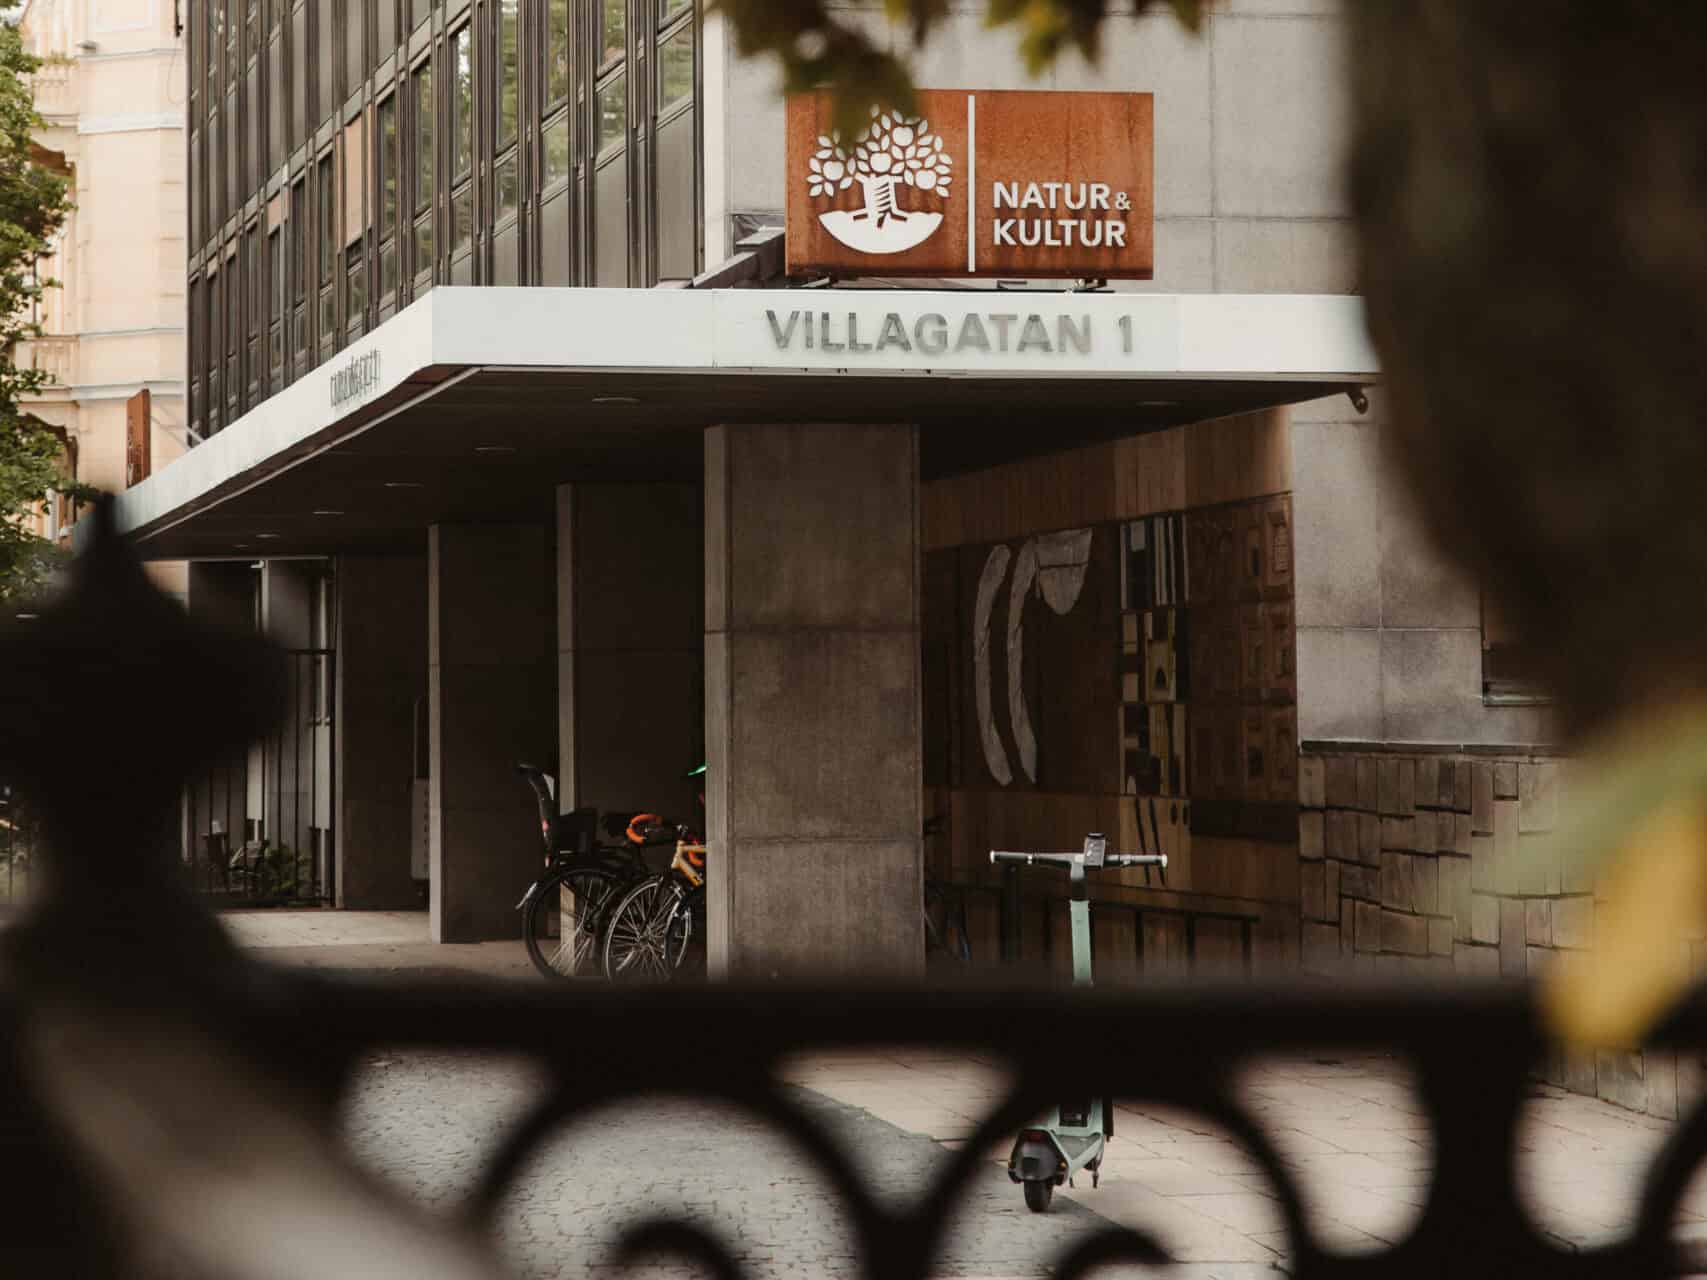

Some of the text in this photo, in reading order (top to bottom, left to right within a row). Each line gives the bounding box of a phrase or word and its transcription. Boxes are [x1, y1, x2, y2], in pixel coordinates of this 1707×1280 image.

[992, 182, 1111, 210] NATUR
[993, 219, 1127, 248] KULTUR
[766, 309, 1134, 354] VILLAGATAN 1
